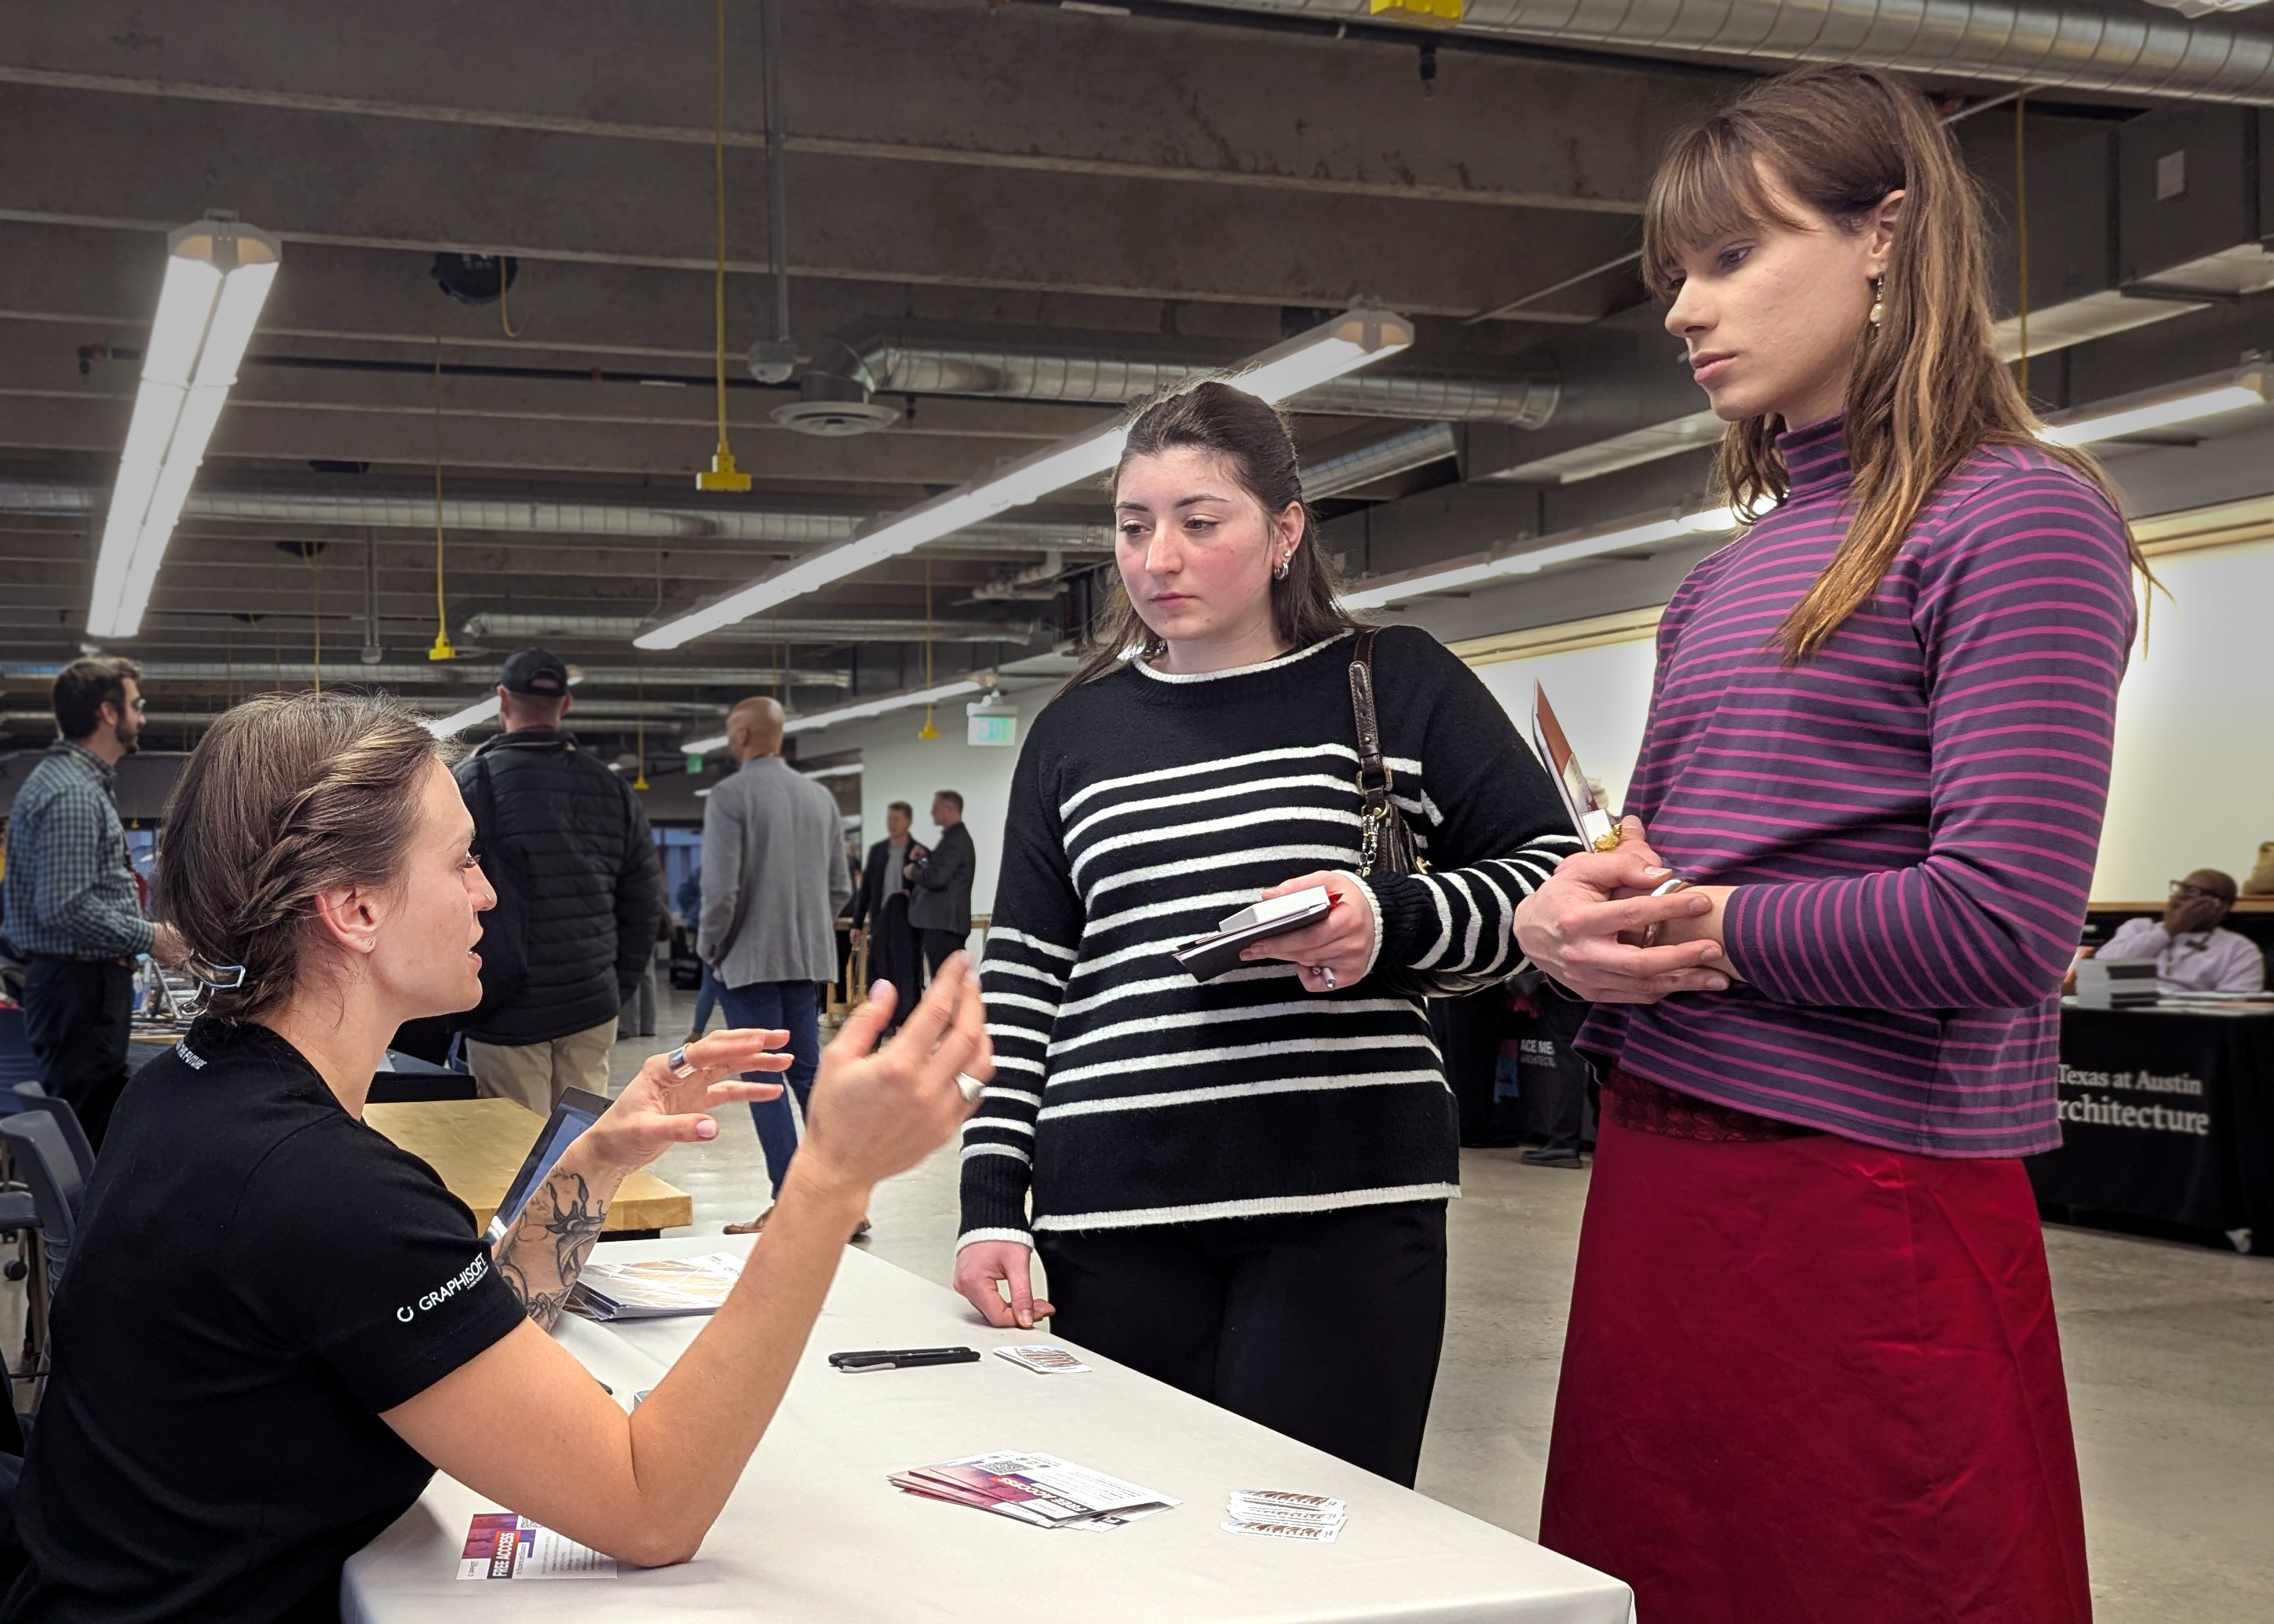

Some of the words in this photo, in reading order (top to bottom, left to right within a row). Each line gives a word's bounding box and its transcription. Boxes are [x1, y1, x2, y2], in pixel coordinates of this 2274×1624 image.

[979, 717, 1010, 741] EXIT
[2057, 1064, 2109, 1087] Texas
[2112, 1072, 2133, 1089] at
[2134, 1069, 2203, 1096] Austin
[2057, 1093, 2210, 1135] rchitecture
[418, 1252, 487, 1311] GRAPHISOFT
[491, 1560, 510, 1577] FREE
